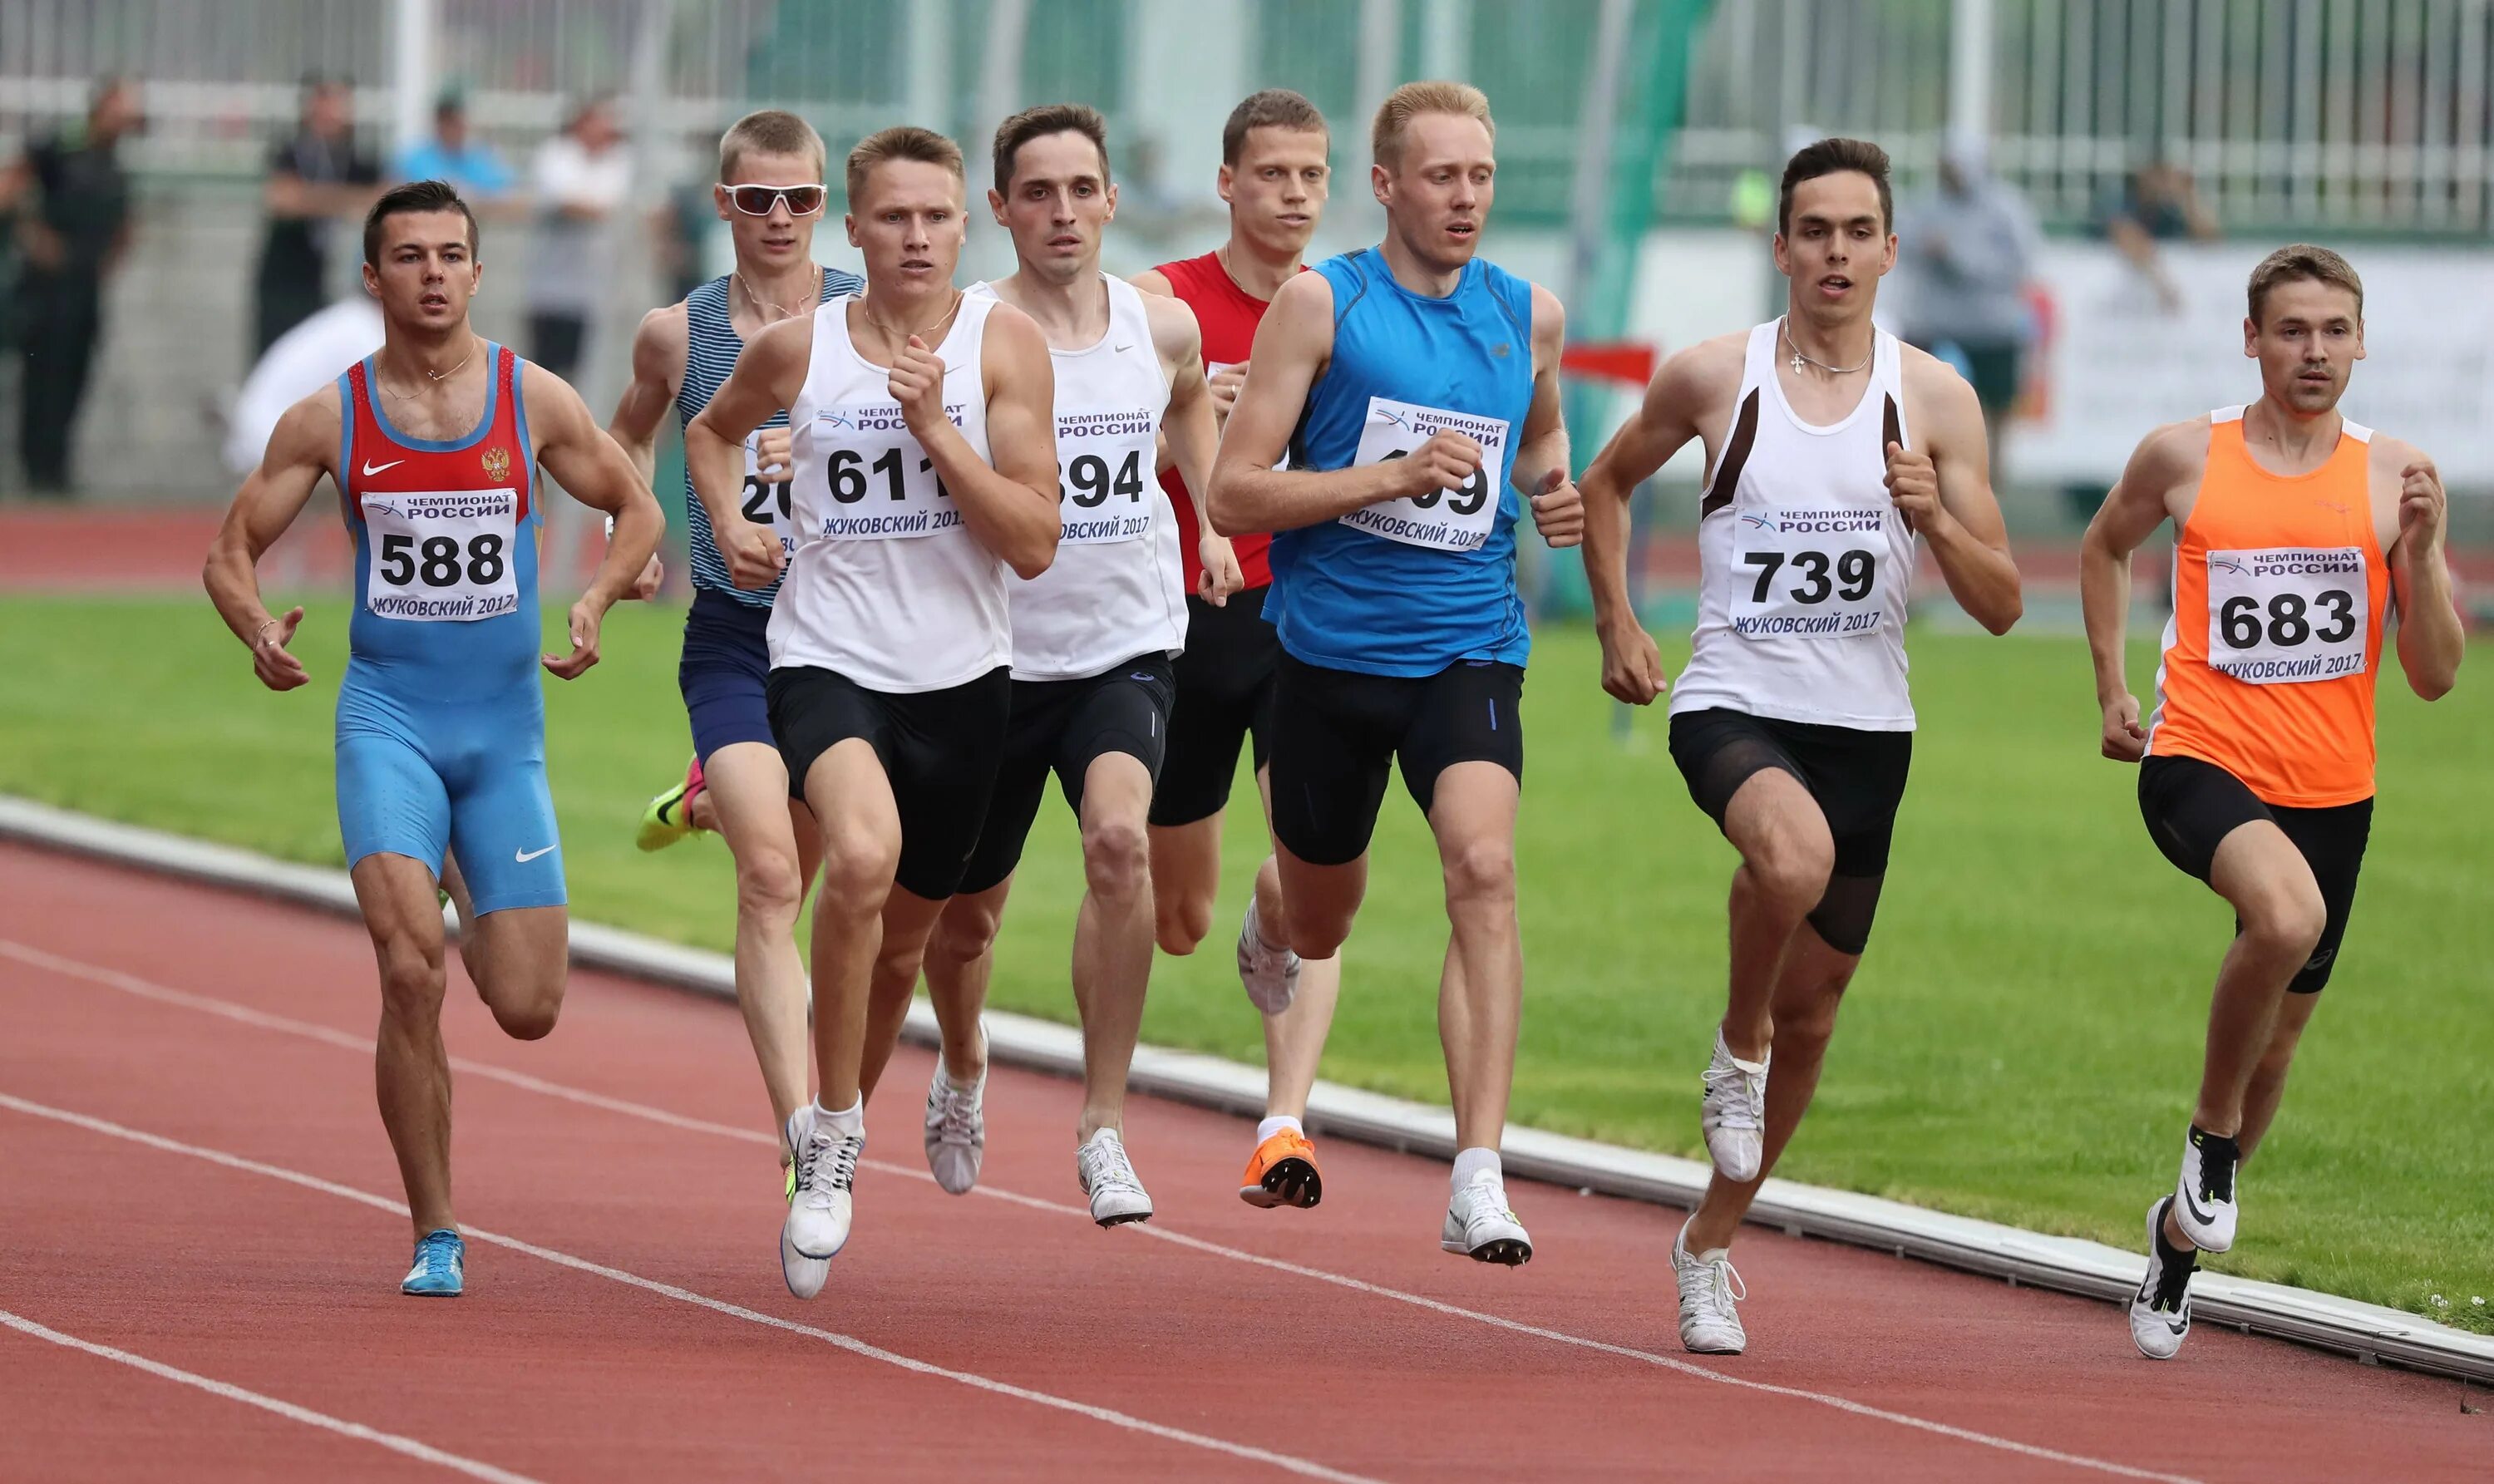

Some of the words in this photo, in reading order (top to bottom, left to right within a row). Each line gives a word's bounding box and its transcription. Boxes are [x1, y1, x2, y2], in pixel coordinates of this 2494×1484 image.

[858, 404, 964, 417] ЧЕМПАТ
[1058, 412, 1151, 425] ЧЕМПИОНАТ
[858, 415, 963, 431] РОСИ
[1059, 422, 1151, 438] РОССИИ
[1416, 412, 1503, 434] ЧЕМПИОНАТ
[1413, 422, 1500, 447] РОИИ
[1057, 450, 1143, 508] 94
[407, 494, 510, 506] ЧЕМПИОНАТ
[407, 504, 510, 520] РОССИИ
[1780, 510, 1883, 520] ЧЕМПИОНАТ
[823, 510, 928, 535] ЖУКОВСКИЙ
[931, 510, 965, 530] 201
[1122, 516, 1150, 535] 2017
[1344, 509, 1448, 544] ЖУКОВСКИЙ
[1448, 528, 1486, 547] 2017
[1780, 520, 1880, 533] РОССИИ
[380, 533, 504, 588] 588
[2254, 552, 2358, 564] ЧЕМПИОНАТ
[1743, 549, 1875, 604] 739
[2254, 563, 2358, 577] РОССИИ
[373, 595, 474, 616] ЖУКОВСКИЙ
[476, 594, 516, 614] 2017
[1734, 611, 1841, 634] ЖУКОВСКИЙ
[1842, 611, 1880, 632] 2017
[2220, 589, 2356, 650] 683
[2216, 654, 2322, 678] ЖУКОВСКИЙ
[2325, 652, 2362, 673] 2017
